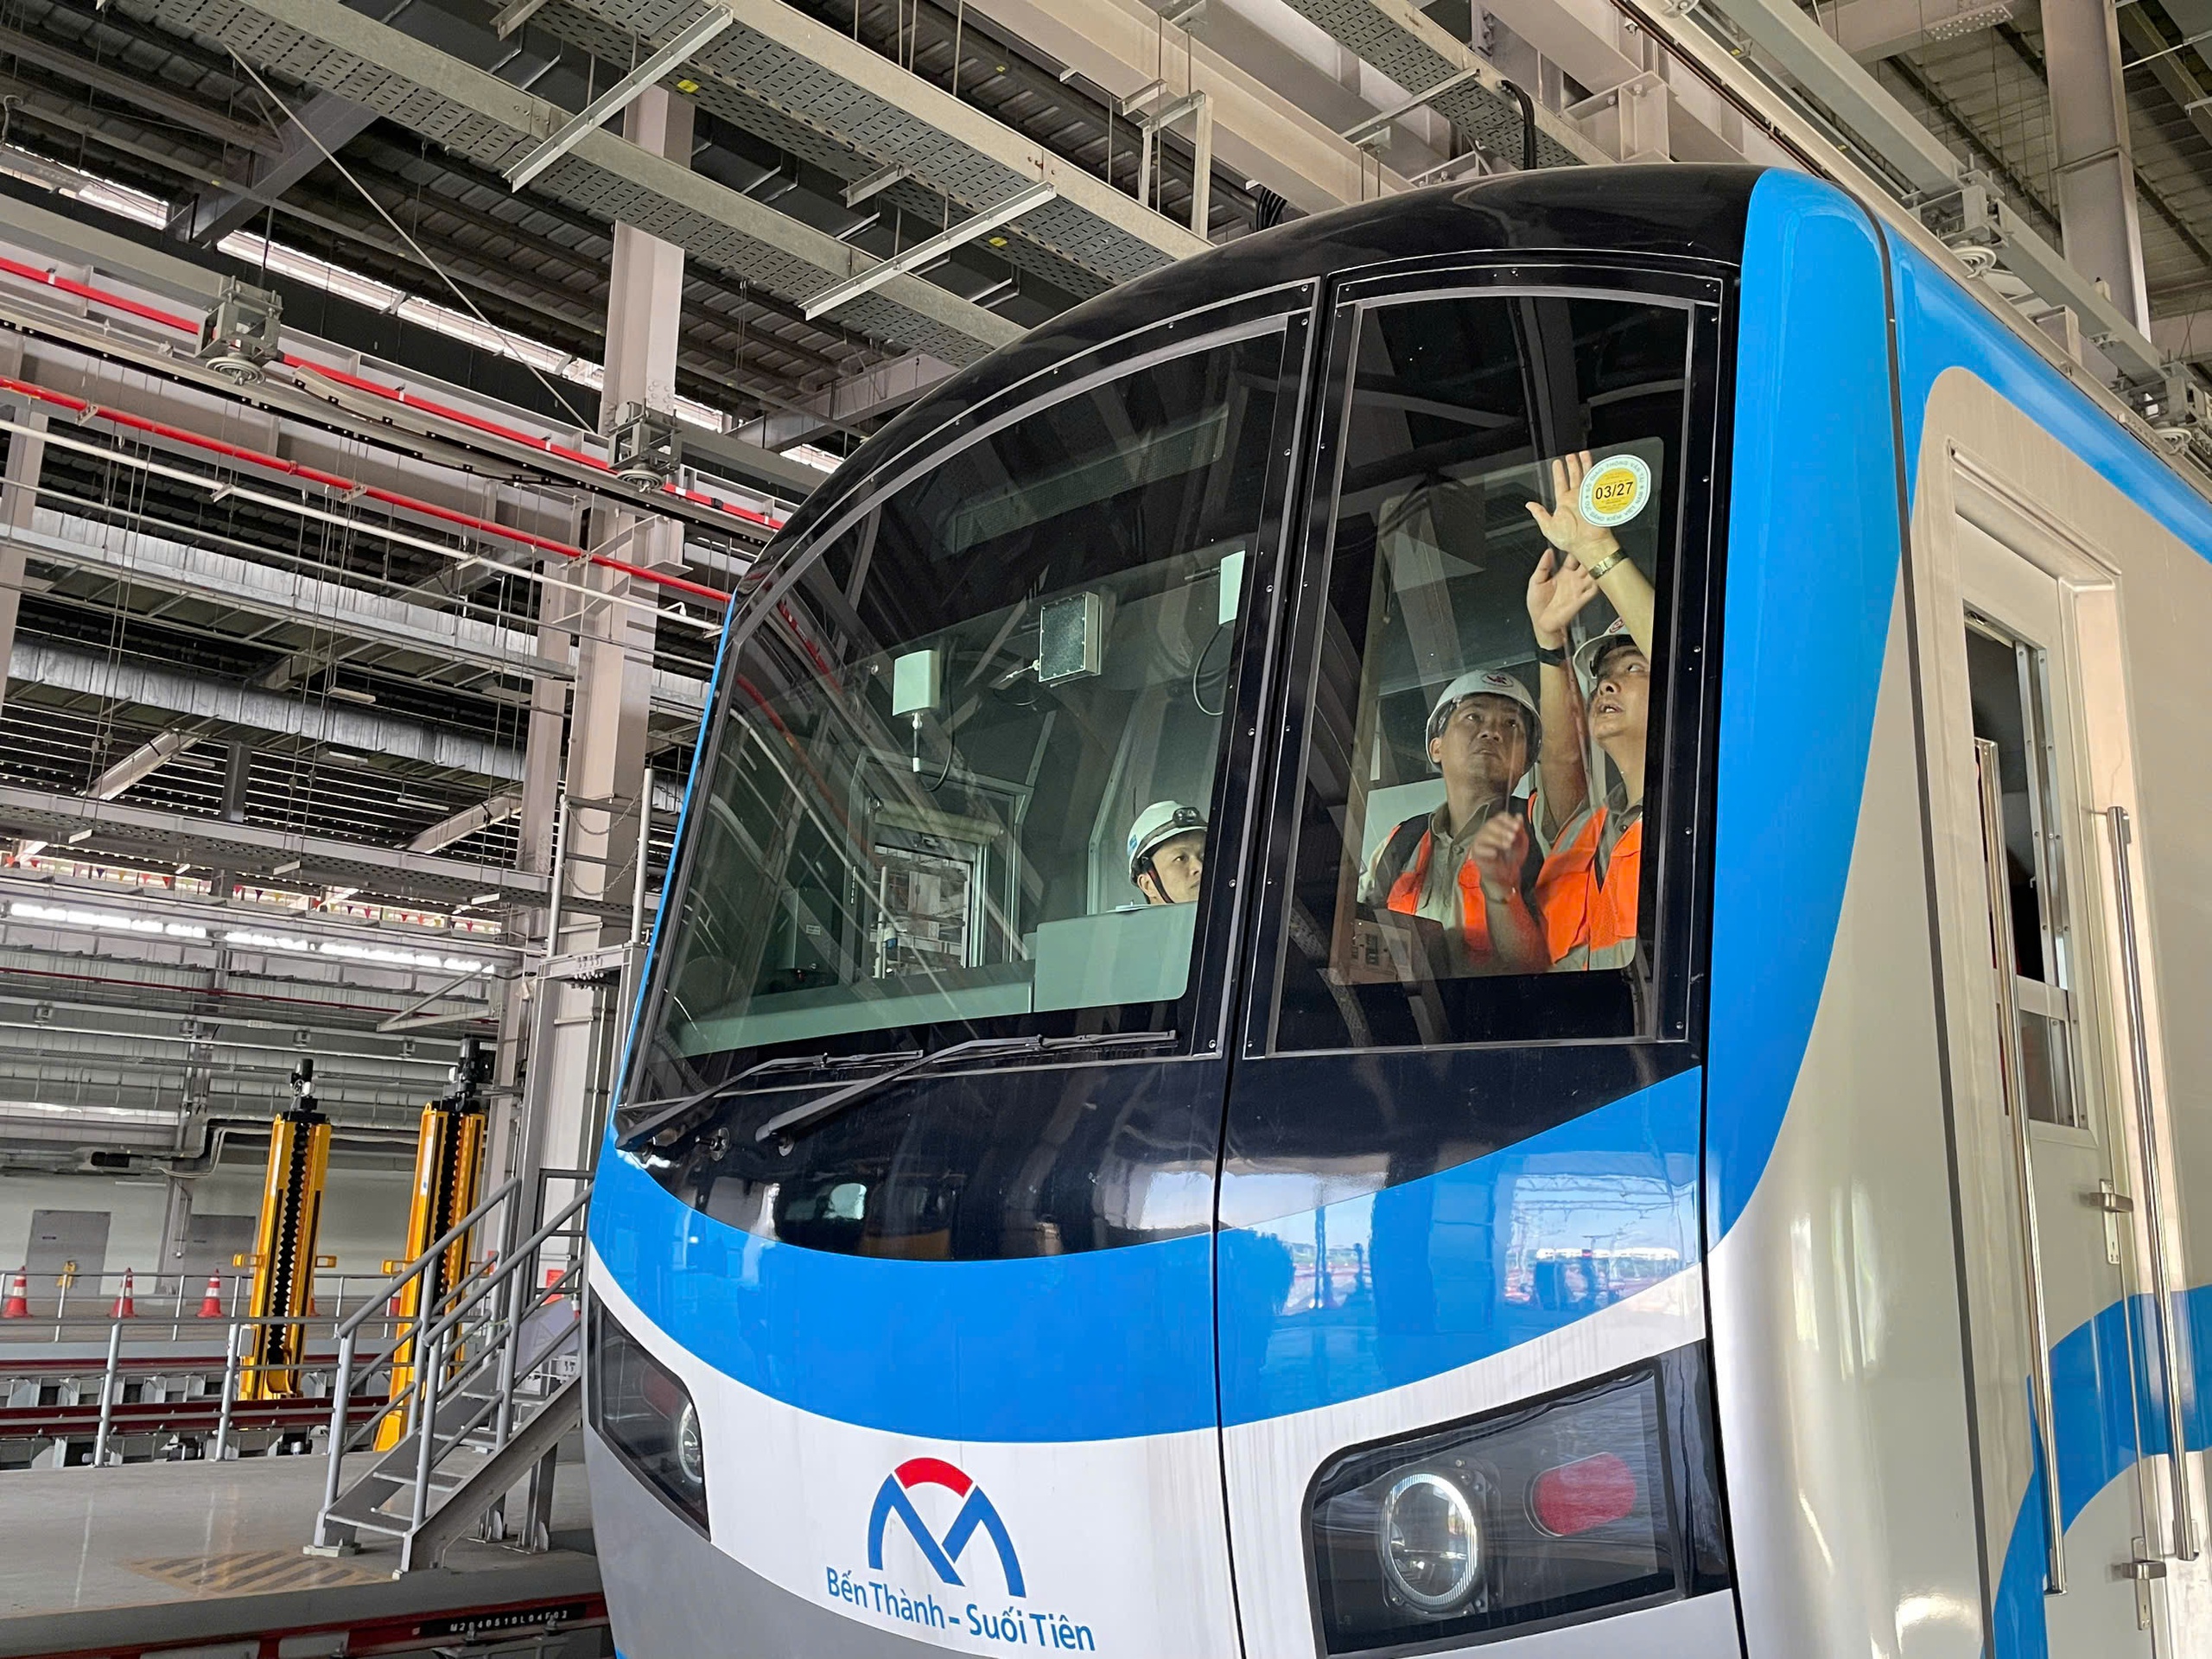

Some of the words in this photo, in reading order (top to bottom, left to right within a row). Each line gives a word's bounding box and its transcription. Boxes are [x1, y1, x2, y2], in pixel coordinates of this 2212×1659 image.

[1595, 481, 1634, 500] 03/27
[826, 1566, 868, 1608] Bến
[868, 1580, 945, 1630] Thành
[965, 1604, 1027, 1644] Suối
[1028, 1613, 1096, 1651] Tiên
